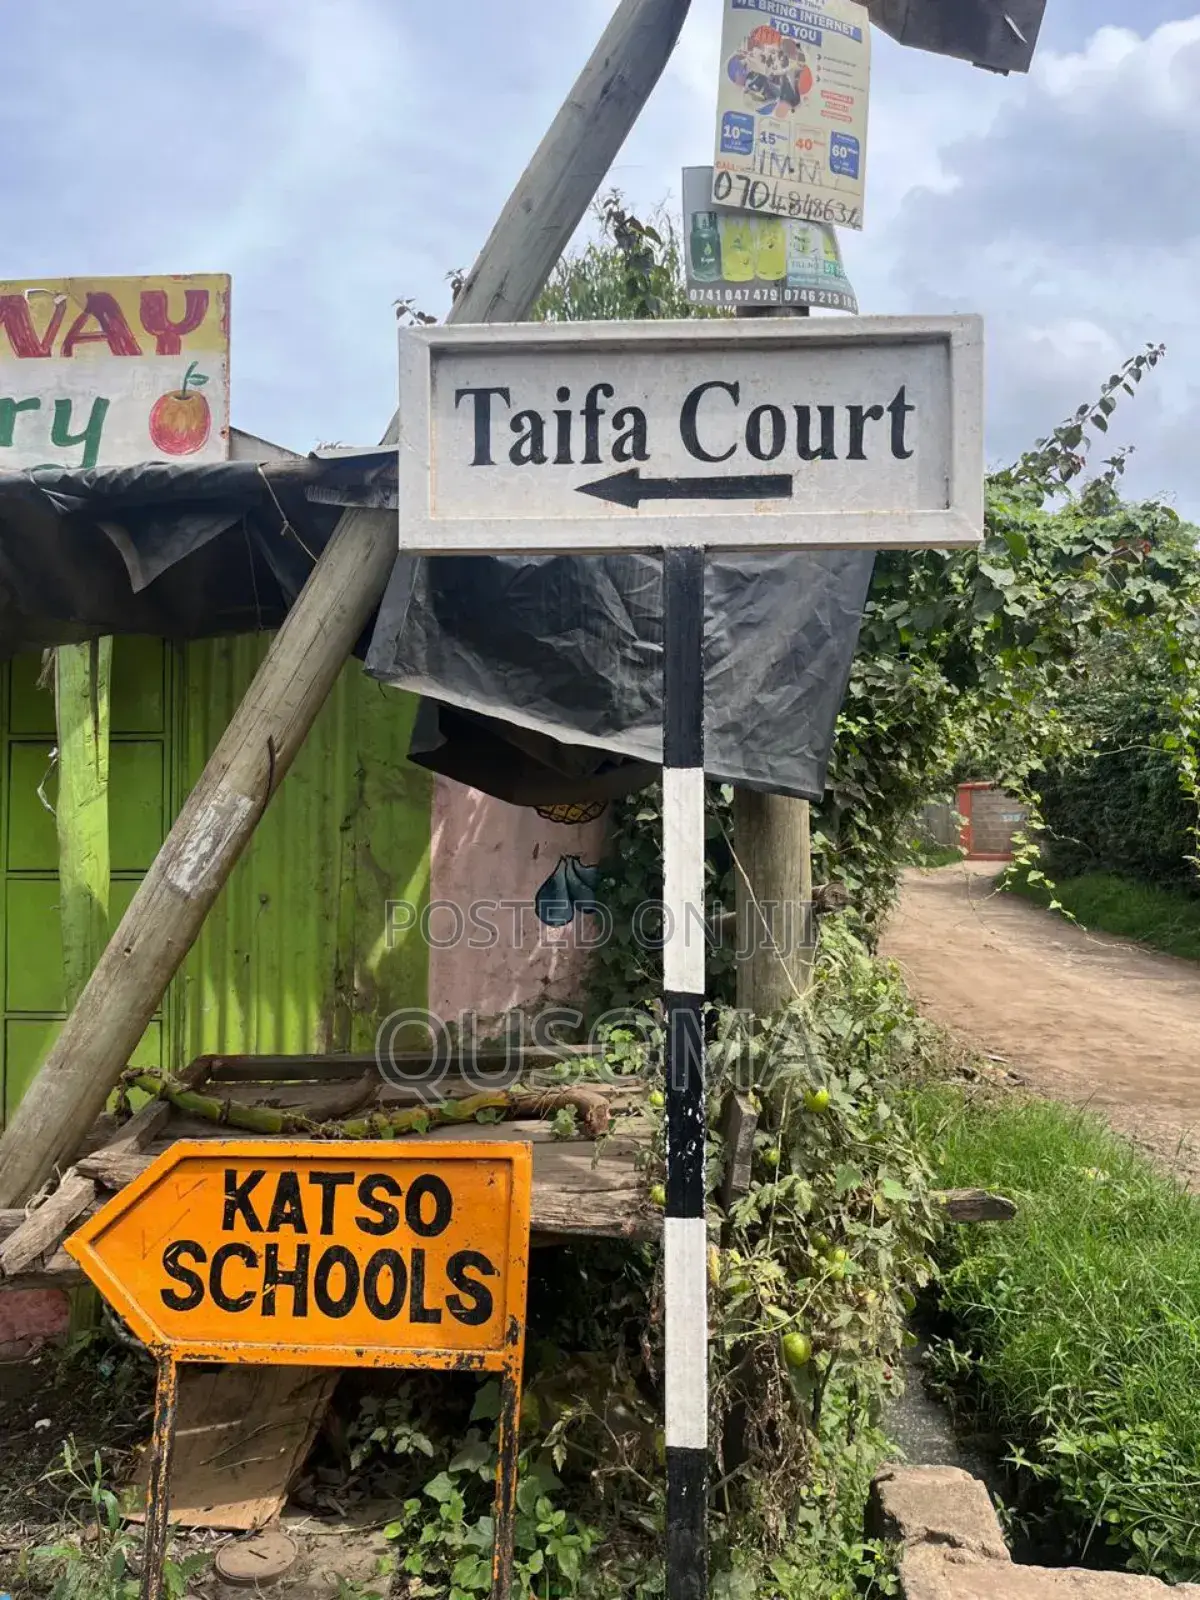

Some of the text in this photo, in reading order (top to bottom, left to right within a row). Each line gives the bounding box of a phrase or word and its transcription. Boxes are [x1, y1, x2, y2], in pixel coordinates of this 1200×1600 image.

[758, 0, 797, 18] BRING
[800, 9, 855, 35] INTERNET
[775, 20, 816, 41] TO YOU
[690, 289, 721, 301] 0741
[784, 289, 816, 302] 0746
[455, 381, 915, 466] Taifa Court
[221, 1169, 453, 1237] KATSO
[160, 1239, 500, 1327] SCHOOLS
